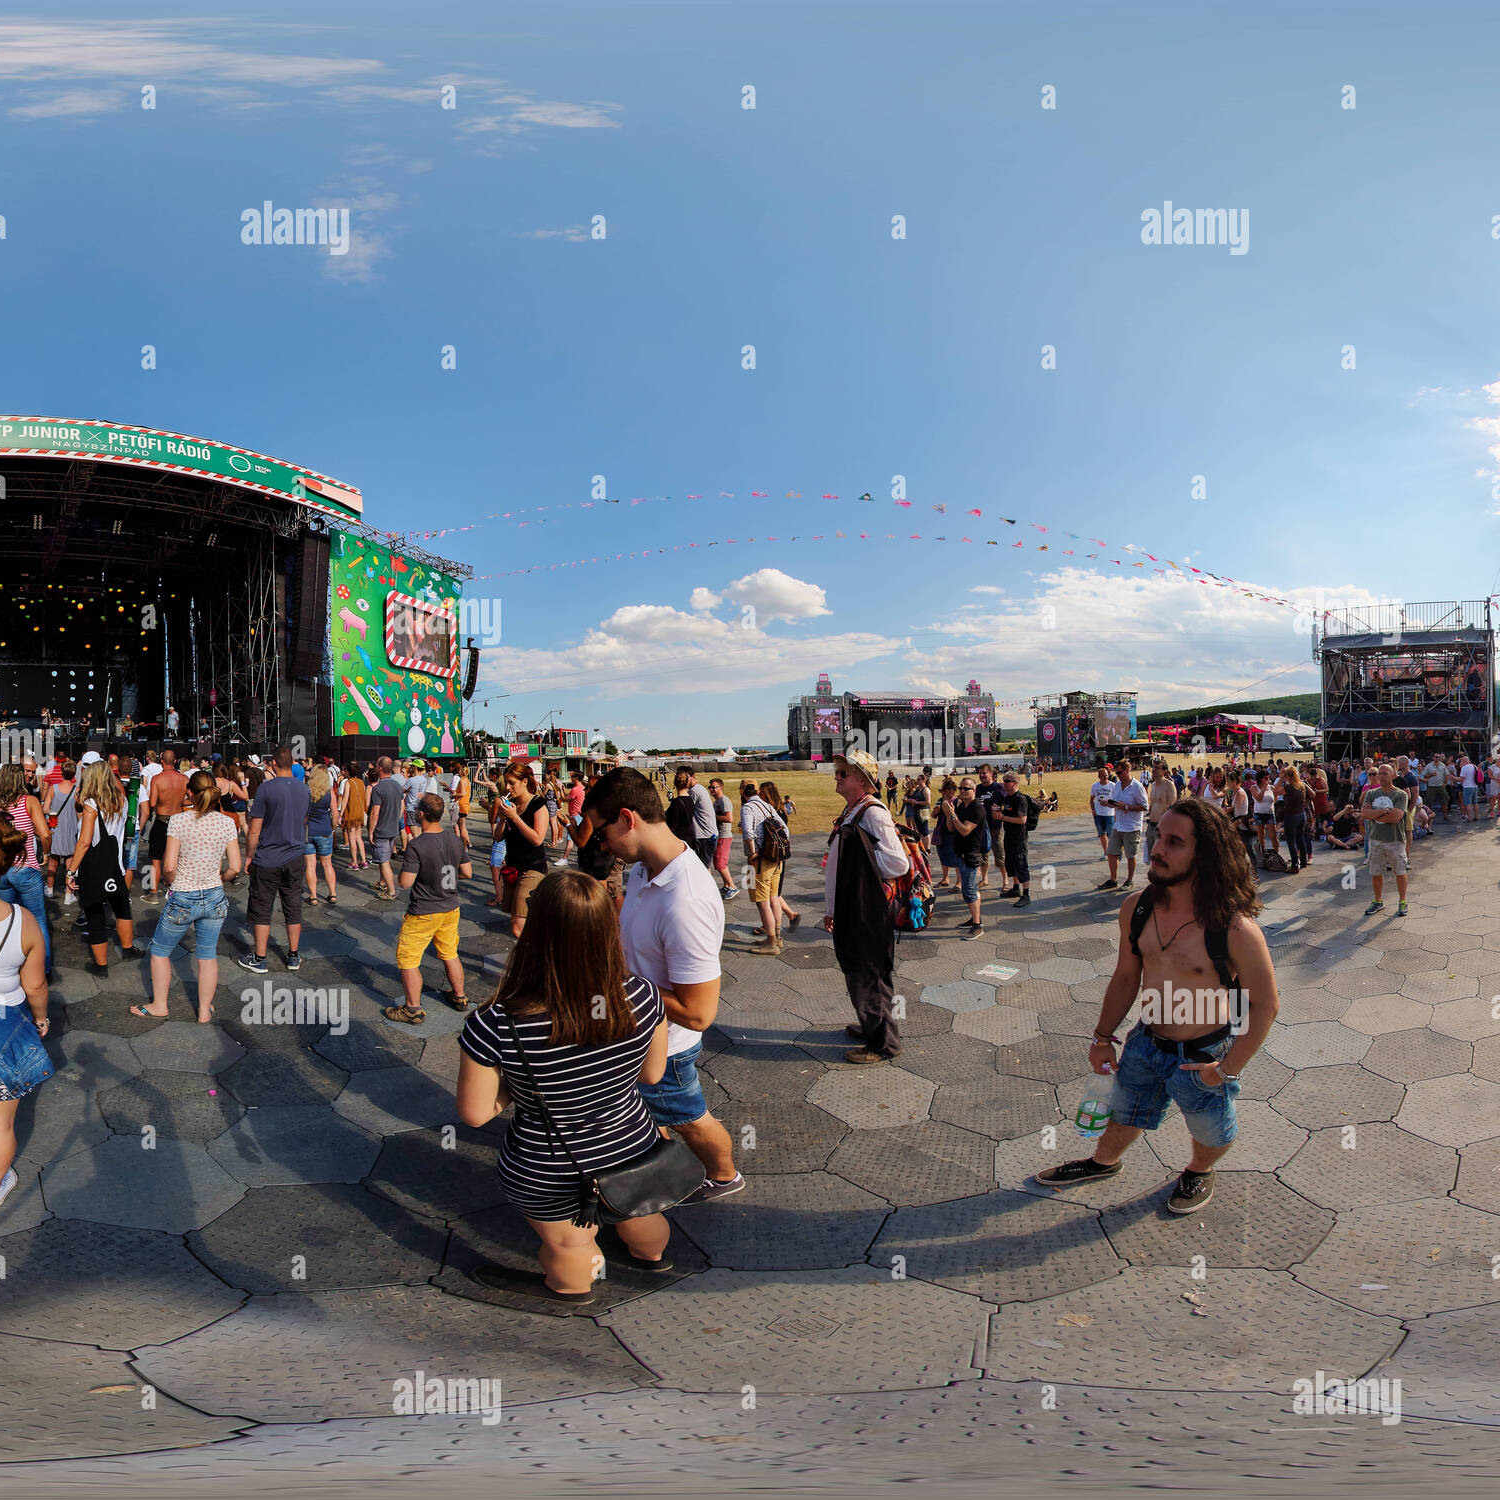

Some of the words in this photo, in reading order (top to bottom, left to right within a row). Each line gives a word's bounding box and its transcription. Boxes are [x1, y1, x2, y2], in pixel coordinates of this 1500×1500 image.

[19, 425, 81, 441] JUNIOR
[108, 431, 161, 452] PETŐFI
[167, 440, 211, 461] RÁDIÓ
[52, 440, 149, 457] NAGYSZÍNPAD
[104, 878, 117, 892] 6
